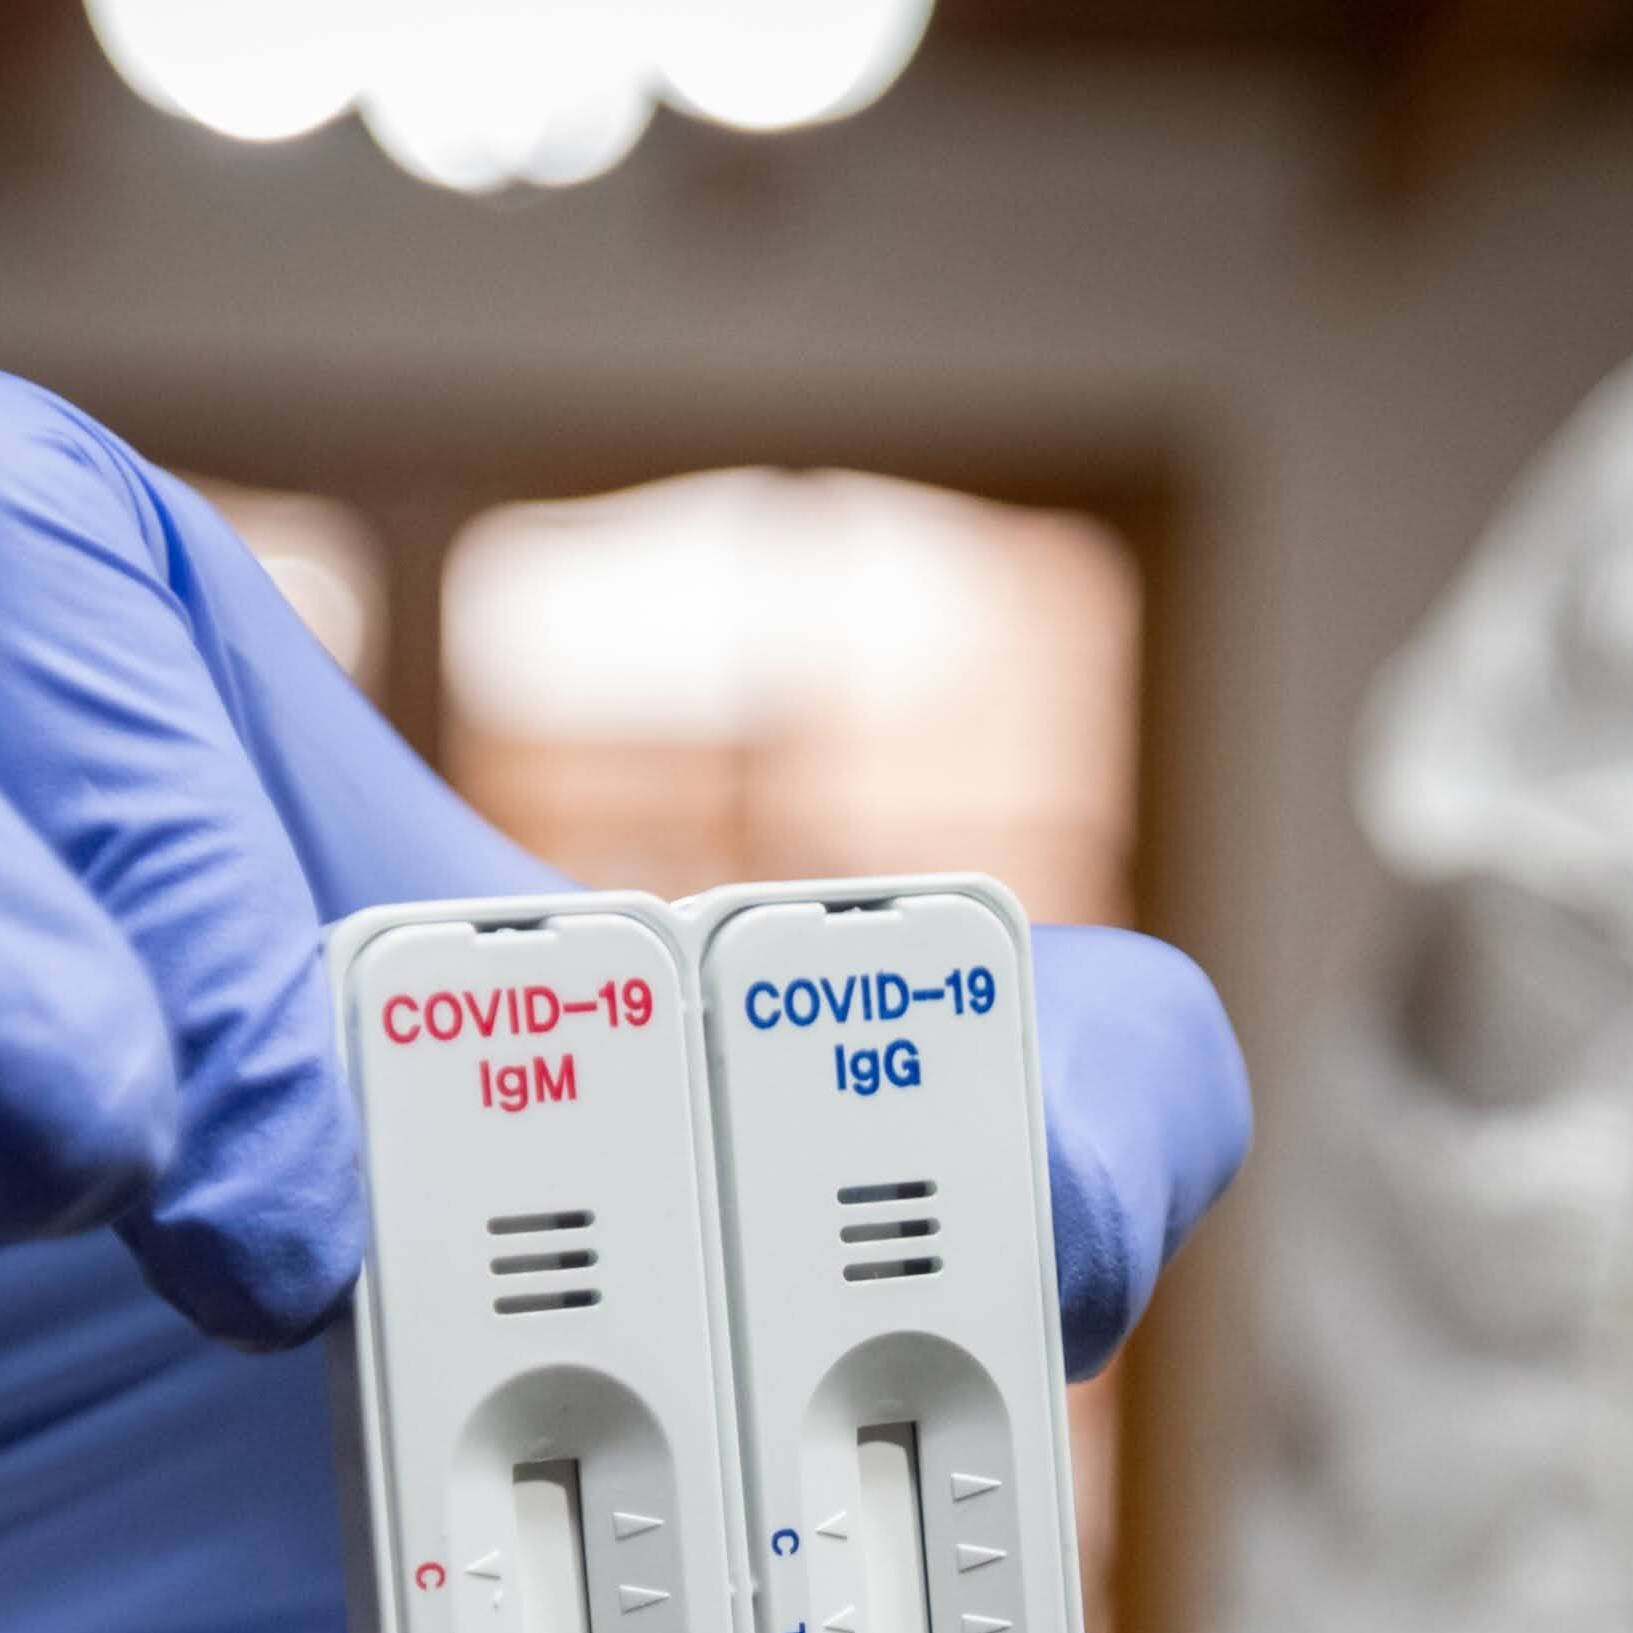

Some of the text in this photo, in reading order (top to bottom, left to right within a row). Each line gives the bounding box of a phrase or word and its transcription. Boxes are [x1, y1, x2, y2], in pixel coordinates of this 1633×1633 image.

[382, 978, 654, 1045] COVID-19
[745, 966, 997, 1031] COVID-19
[479, 1053, 578, 1114] IgM
[834, 1038, 923, 1098] IgG
[771, 1528, 800, 1556] C
[415, 1562, 447, 1591] C
